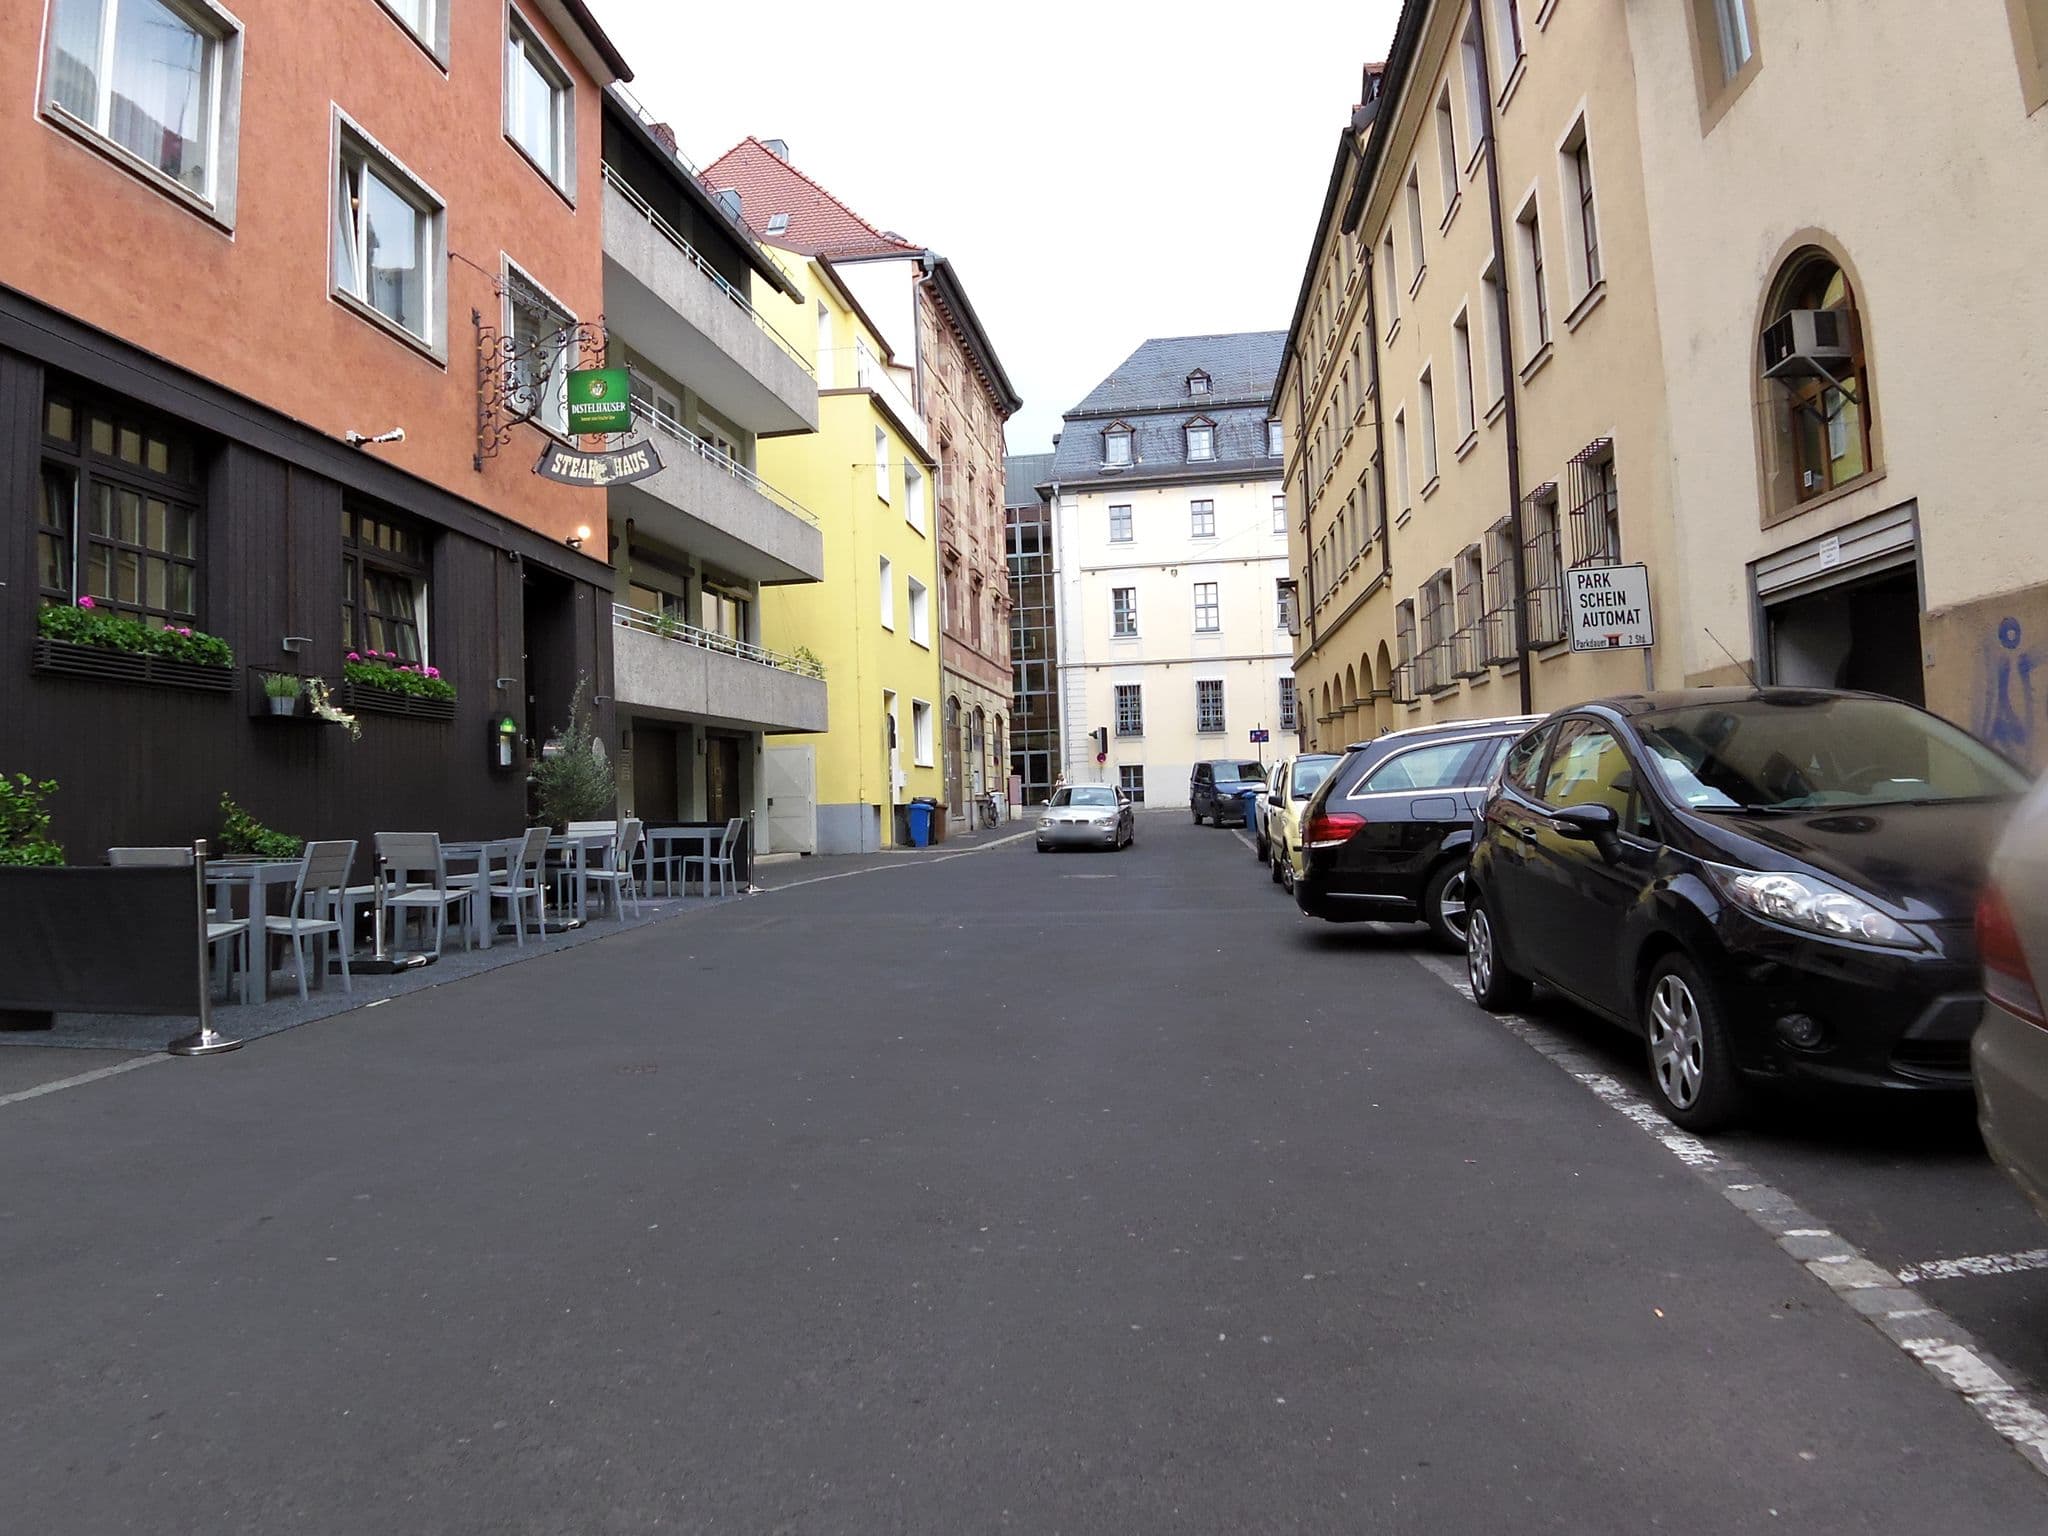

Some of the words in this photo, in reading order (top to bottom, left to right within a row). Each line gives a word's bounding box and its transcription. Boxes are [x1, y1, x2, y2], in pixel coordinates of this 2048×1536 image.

[613, 450, 649, 477] HAUS
[1577, 572, 1611, 589] PARK
[1580, 590, 1626, 608] SCHEIN
[1582, 608, 1640, 627] AUTOMAT
